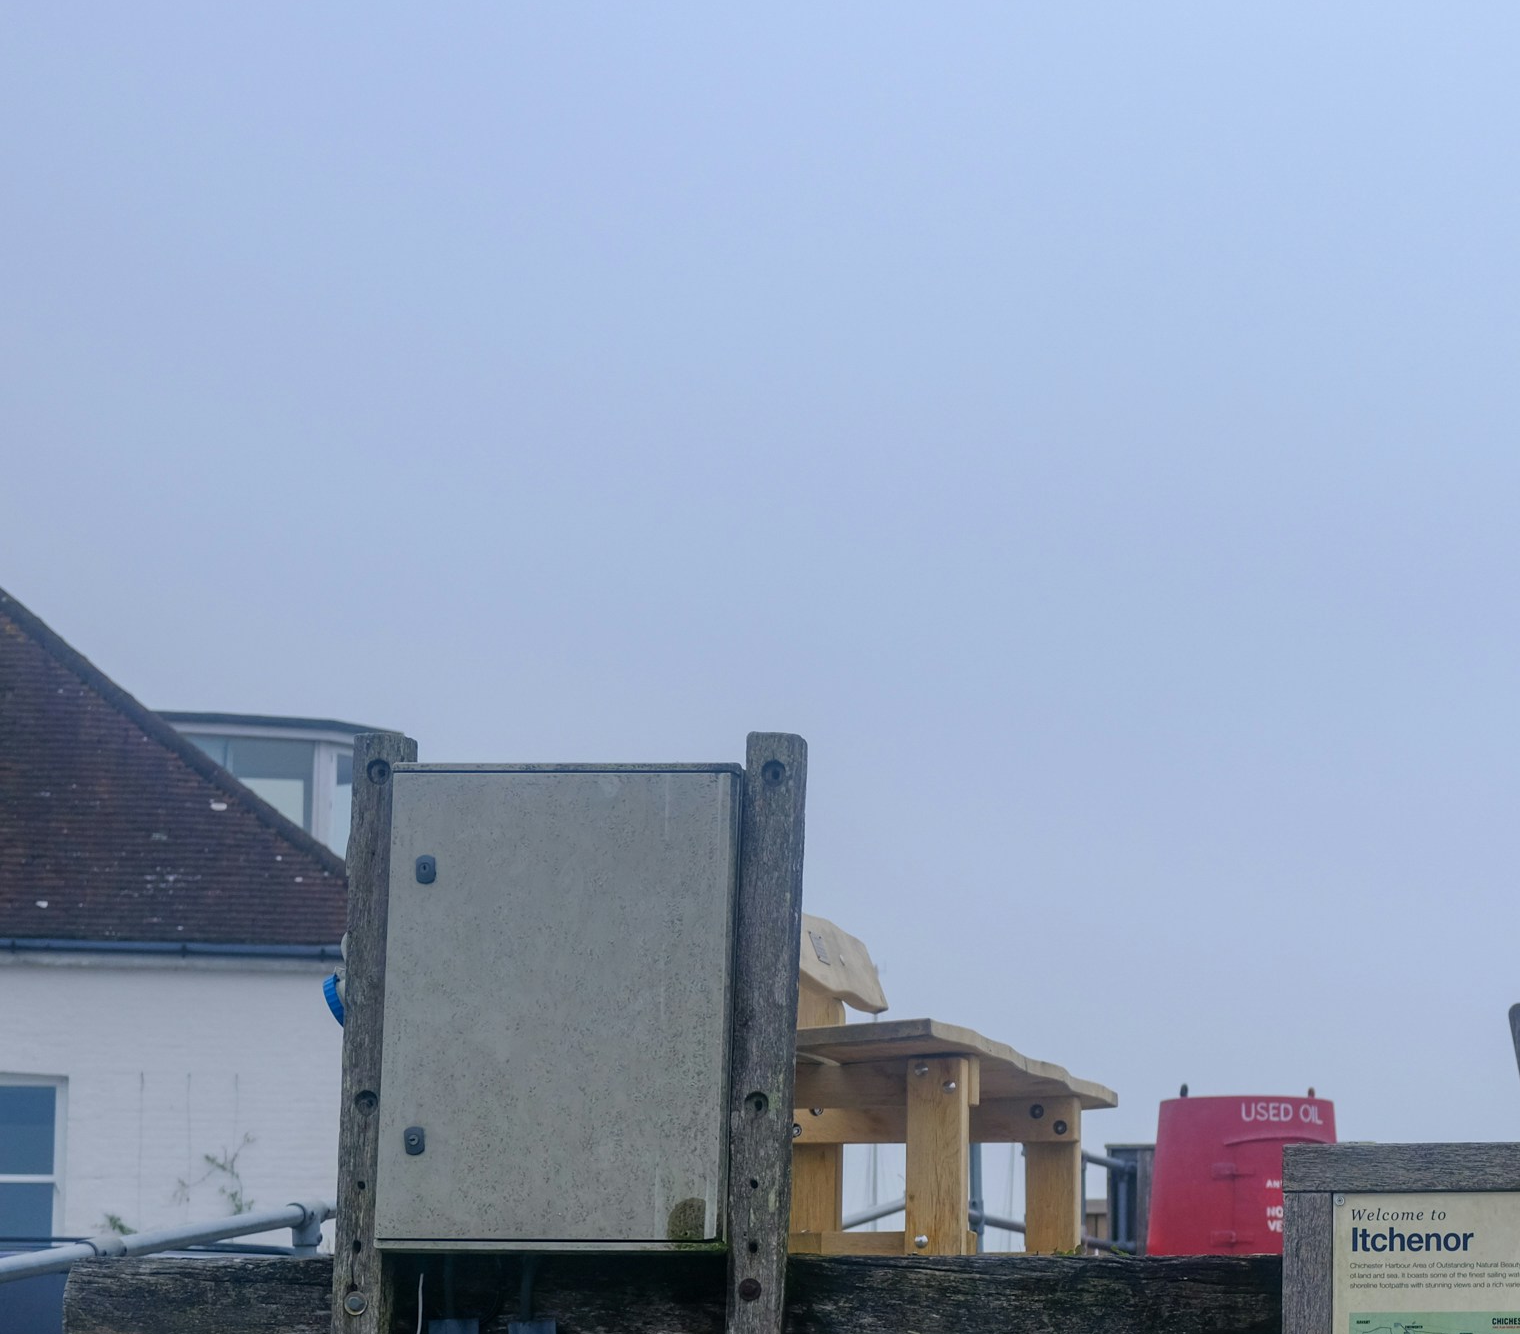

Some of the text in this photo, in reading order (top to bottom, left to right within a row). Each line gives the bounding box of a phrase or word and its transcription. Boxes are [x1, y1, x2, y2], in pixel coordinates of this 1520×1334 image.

[1241, 1102, 1323, 1125] USED OIL
[1266, 1179, 1282, 1189] AN
[1352, 1207, 1446, 1221] Welcome to
[1267, 1219, 1283, 1233] VE
[1352, 1227, 1474, 1252] Itchenor
[1487, 1271, 1506, 1279] sailing
